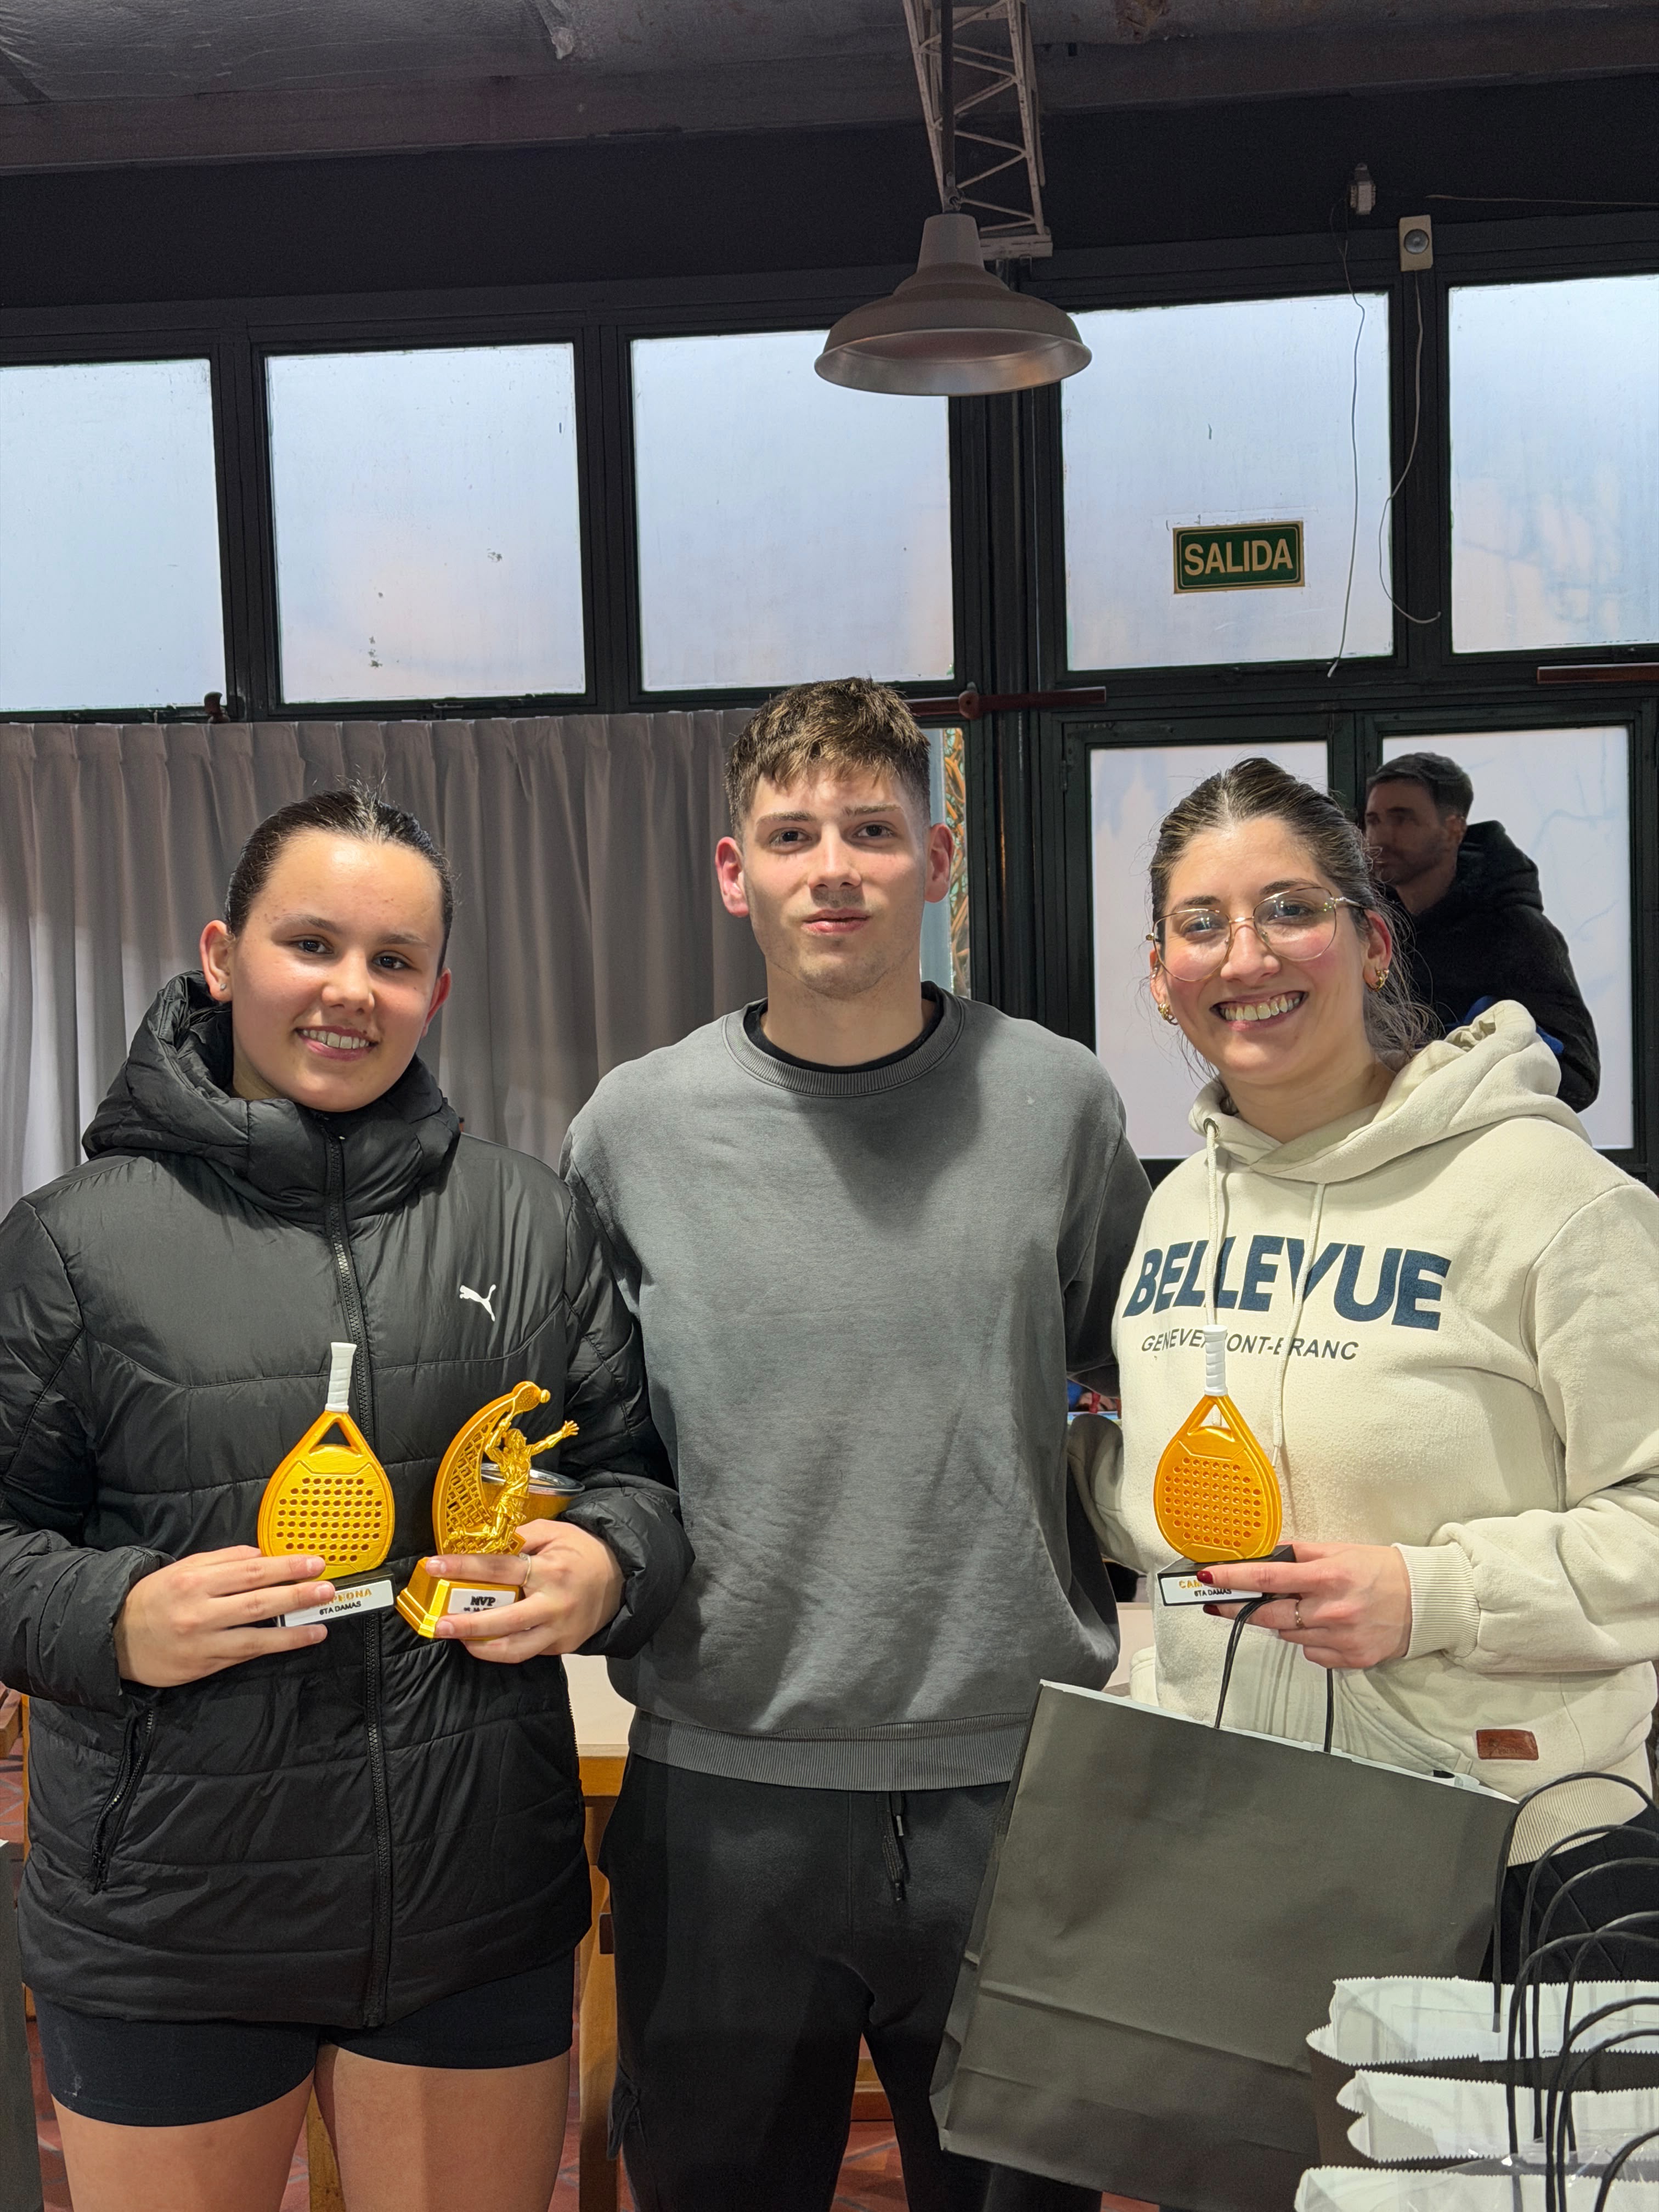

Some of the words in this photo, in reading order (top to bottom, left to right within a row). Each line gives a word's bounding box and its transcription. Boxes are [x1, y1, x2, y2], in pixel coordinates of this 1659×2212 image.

[1184, 538, 1293, 576] SALIDA
[1122, 1235, 1452, 1331] BELLEVUE
[335, 1601, 362, 1612] DAMAS
[470, 1596, 496, 1606] MVP
